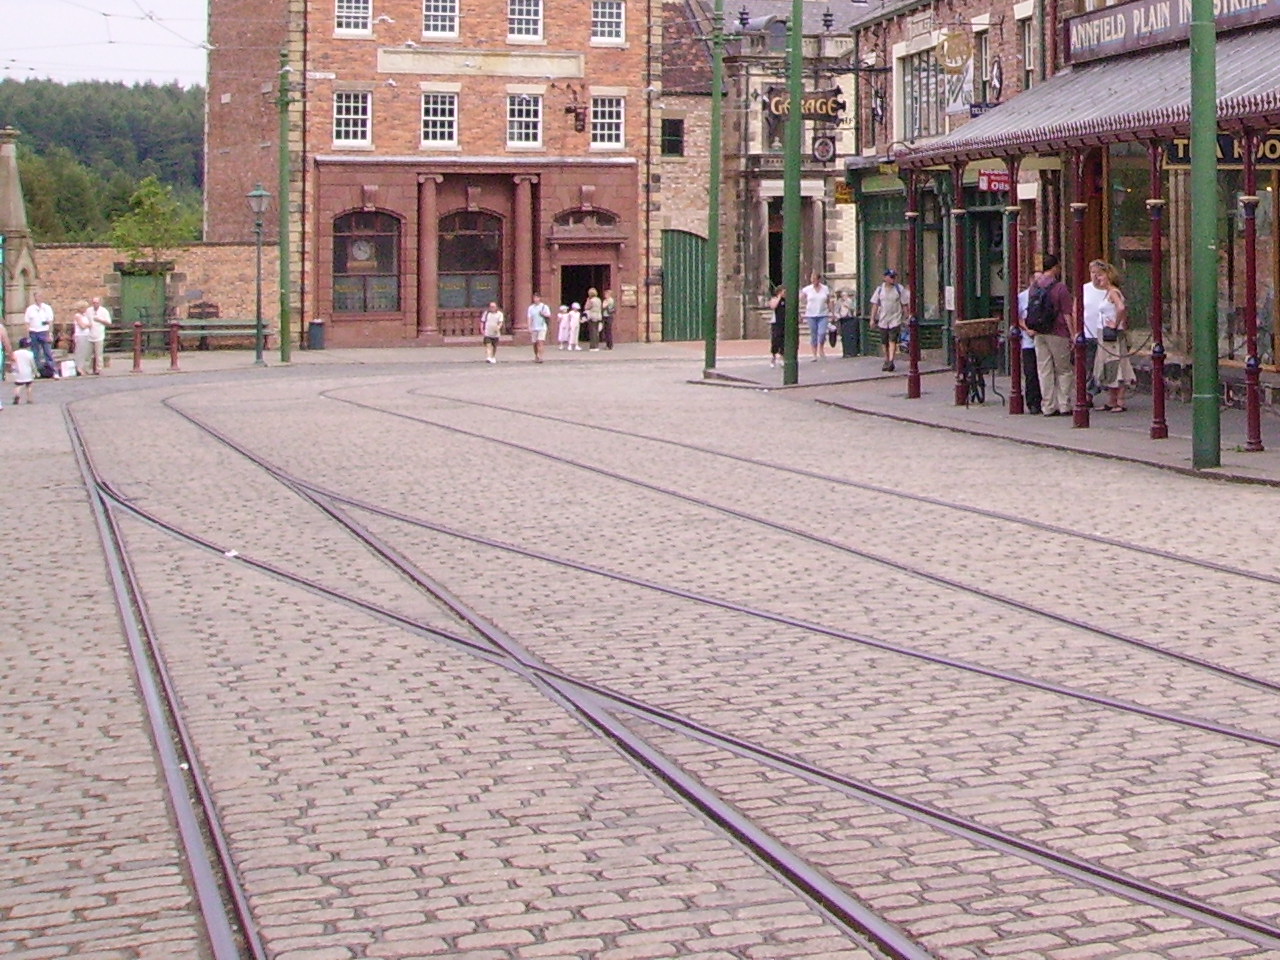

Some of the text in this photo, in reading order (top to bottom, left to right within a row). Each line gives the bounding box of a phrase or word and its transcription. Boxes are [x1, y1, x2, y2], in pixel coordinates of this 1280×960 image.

[1070, 13, 1126, 50] ANNFIELD
[1133, 1, 1171, 35] PLAIN
[1173, 138, 1224, 160] TA
